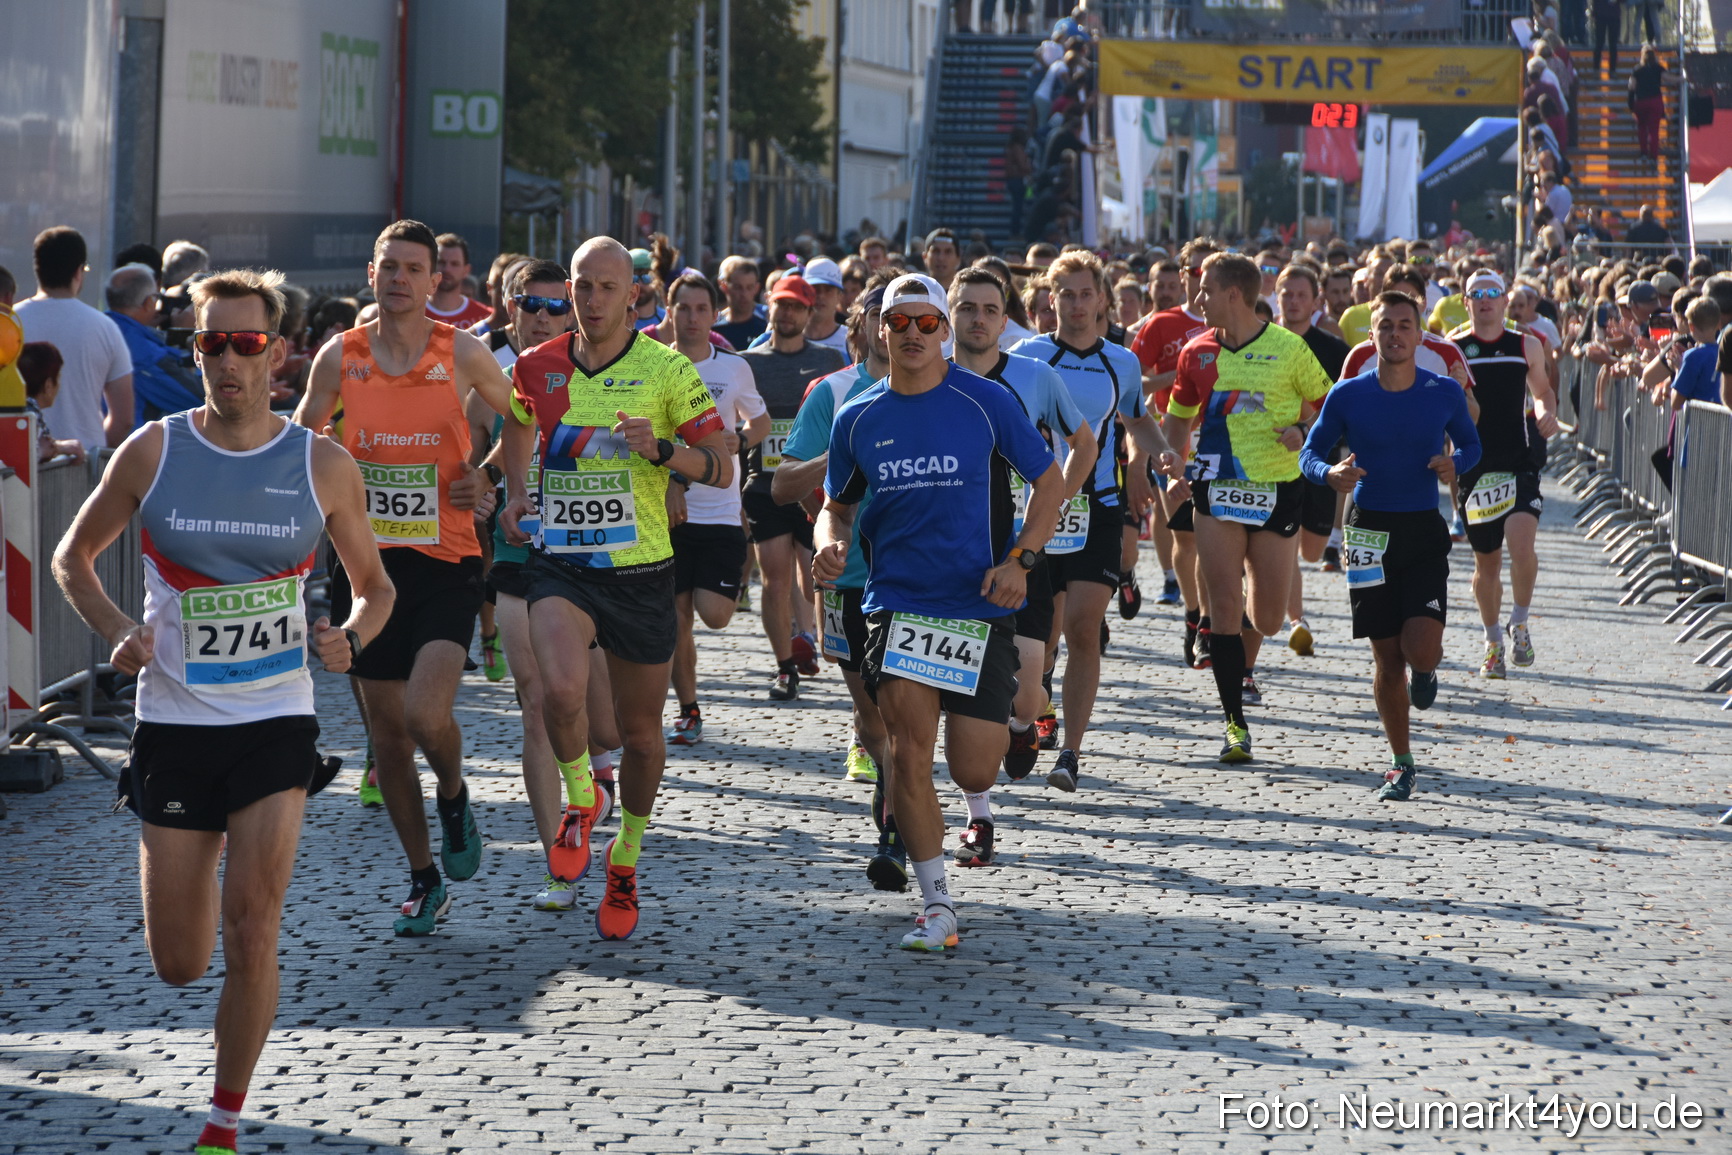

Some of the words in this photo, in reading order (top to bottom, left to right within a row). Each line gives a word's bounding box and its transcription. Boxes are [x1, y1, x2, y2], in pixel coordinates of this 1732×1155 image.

[1238, 54, 1383, 91] START
[320, 47, 376, 141] BOCK
[433, 93, 499, 133] BO
[425, 373, 450, 381] adidas
[373, 433, 441, 446] FitterTEC
[878, 455, 959, 481] SYSCAD
[549, 474, 624, 493] BOCK
[877, 478, 964, 493] www.metalbau-cad.de
[1472, 484, 1510, 507] 1127
[366, 489, 427, 517] 1362
[1215, 489, 1268, 507] 2682
[1477, 502, 1510, 516] FLORIAN
[165, 508, 212, 533] team
[214, 520, 300, 539] memmert
[553, 498, 624, 525] 2699
[1222, 505, 1268, 520] THOMAS
[372, 519, 430, 536] STEFAN
[566, 528, 607, 546] FLO
[191, 583, 289, 616] BOCK
[198, 615, 289, 657] 2741
[898, 627, 972, 666] 2144
[896, 657, 964, 684] ANDREAS
